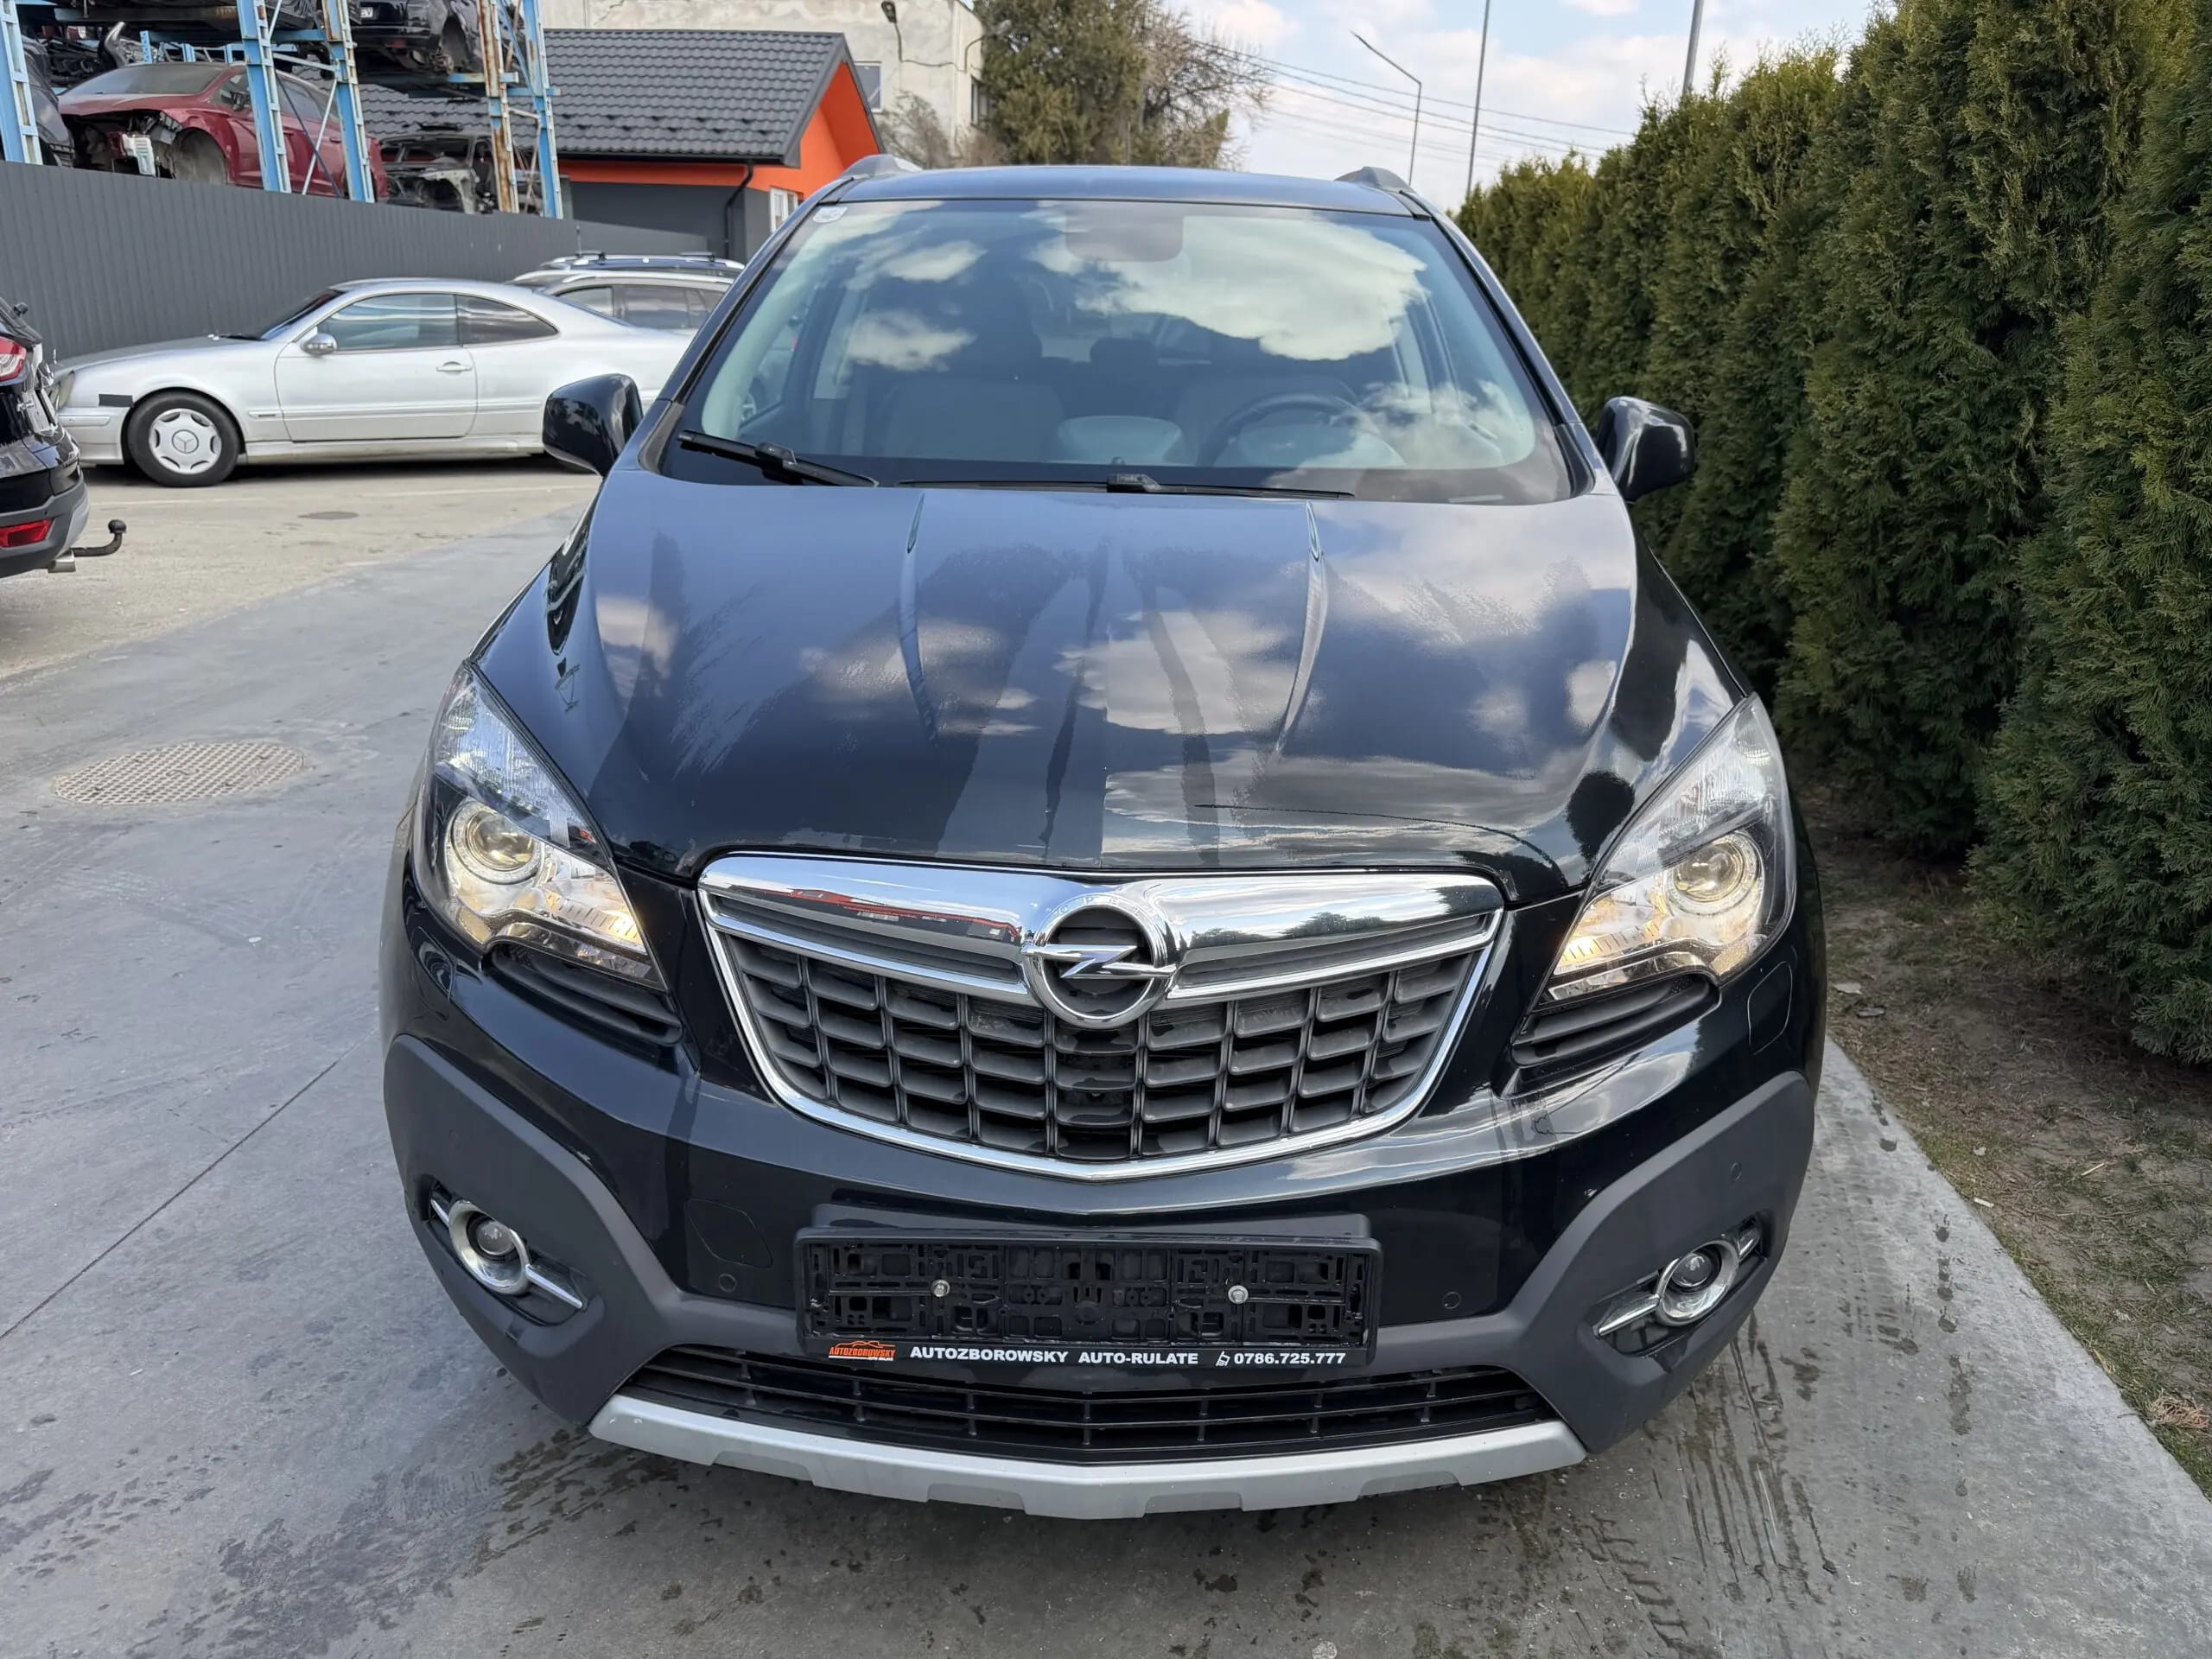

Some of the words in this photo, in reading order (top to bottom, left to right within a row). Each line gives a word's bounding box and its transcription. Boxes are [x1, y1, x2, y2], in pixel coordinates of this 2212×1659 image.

[910, 1346, 1068, 1363] AUTOZBOROWSKY
[1078, 1351, 1198, 1365] AUTO-RULATE
[1234, 1352, 1346, 1365] 0786.725.777
